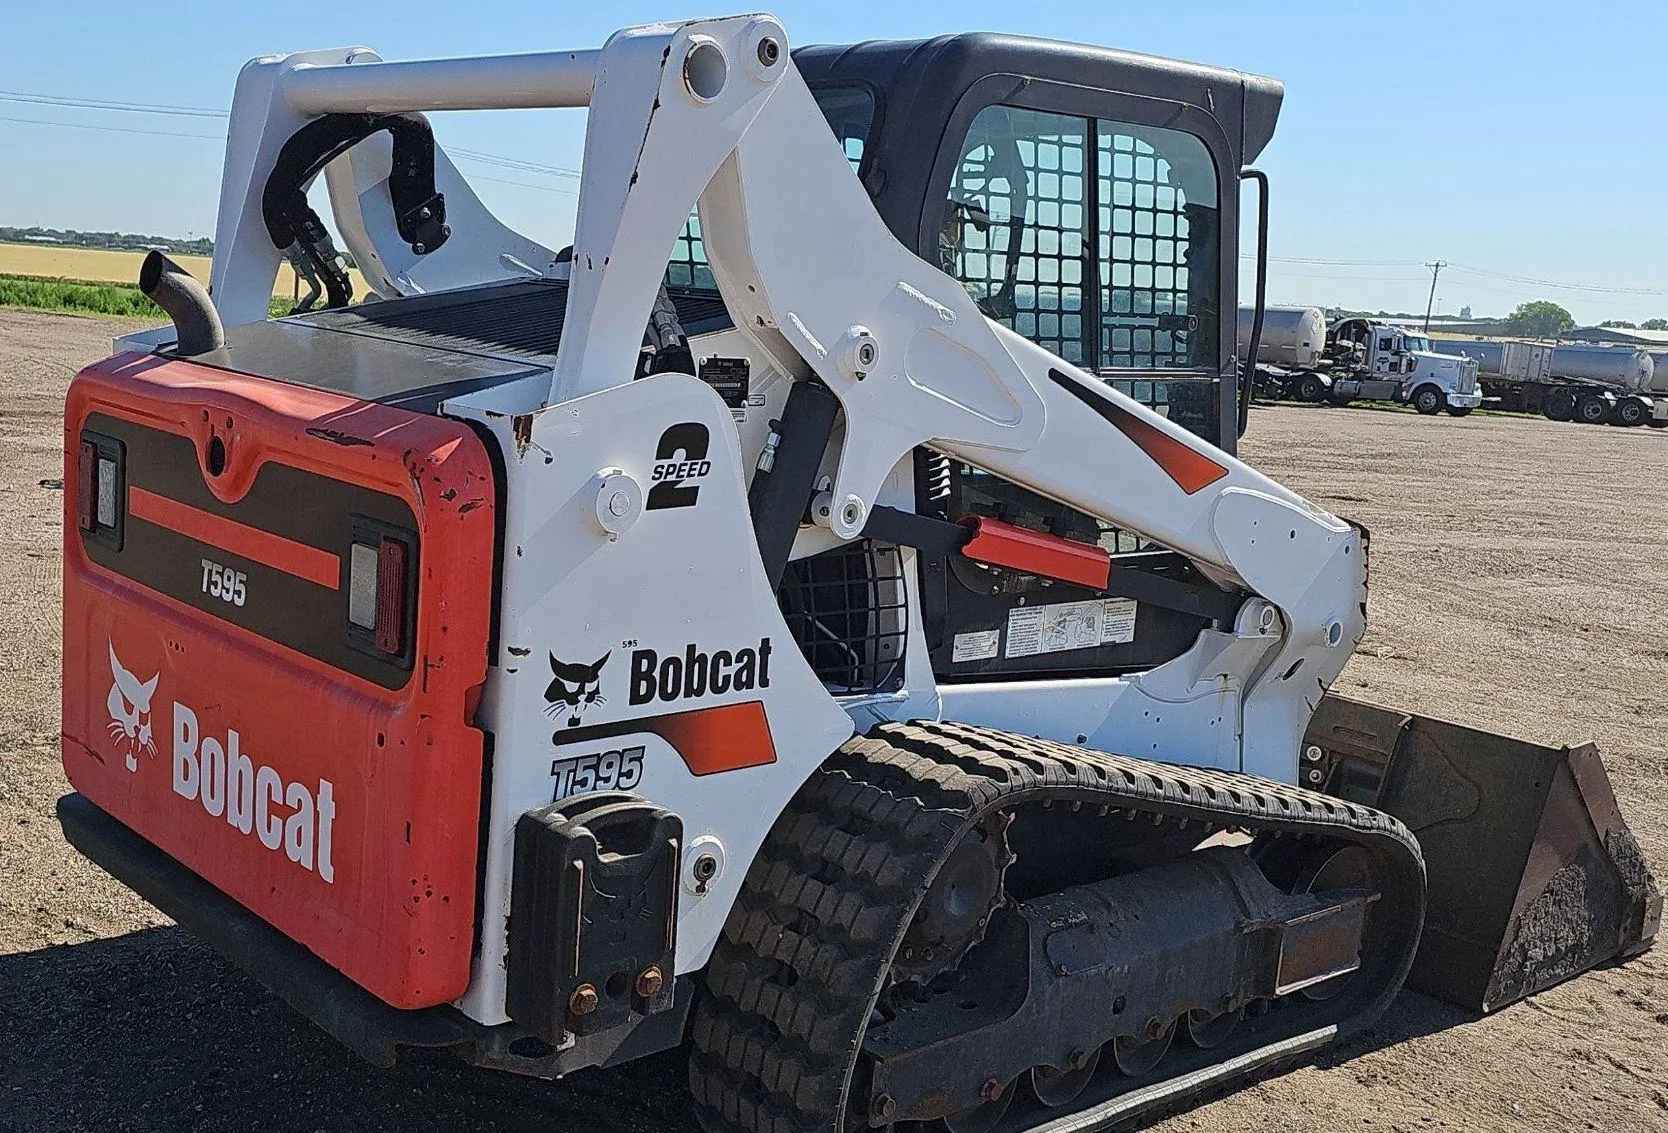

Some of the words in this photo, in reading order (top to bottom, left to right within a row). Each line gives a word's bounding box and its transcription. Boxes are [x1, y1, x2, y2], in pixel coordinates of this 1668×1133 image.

[646, 422, 710, 510] 2
[651, 460, 711, 481] SPEED
[200, 558, 247, 607] T595
[621, 639, 638, 649] 595
[629, 637, 772, 705] Bobcat
[173, 700, 335, 884] Bobcat
[551, 746, 645, 802] T595
